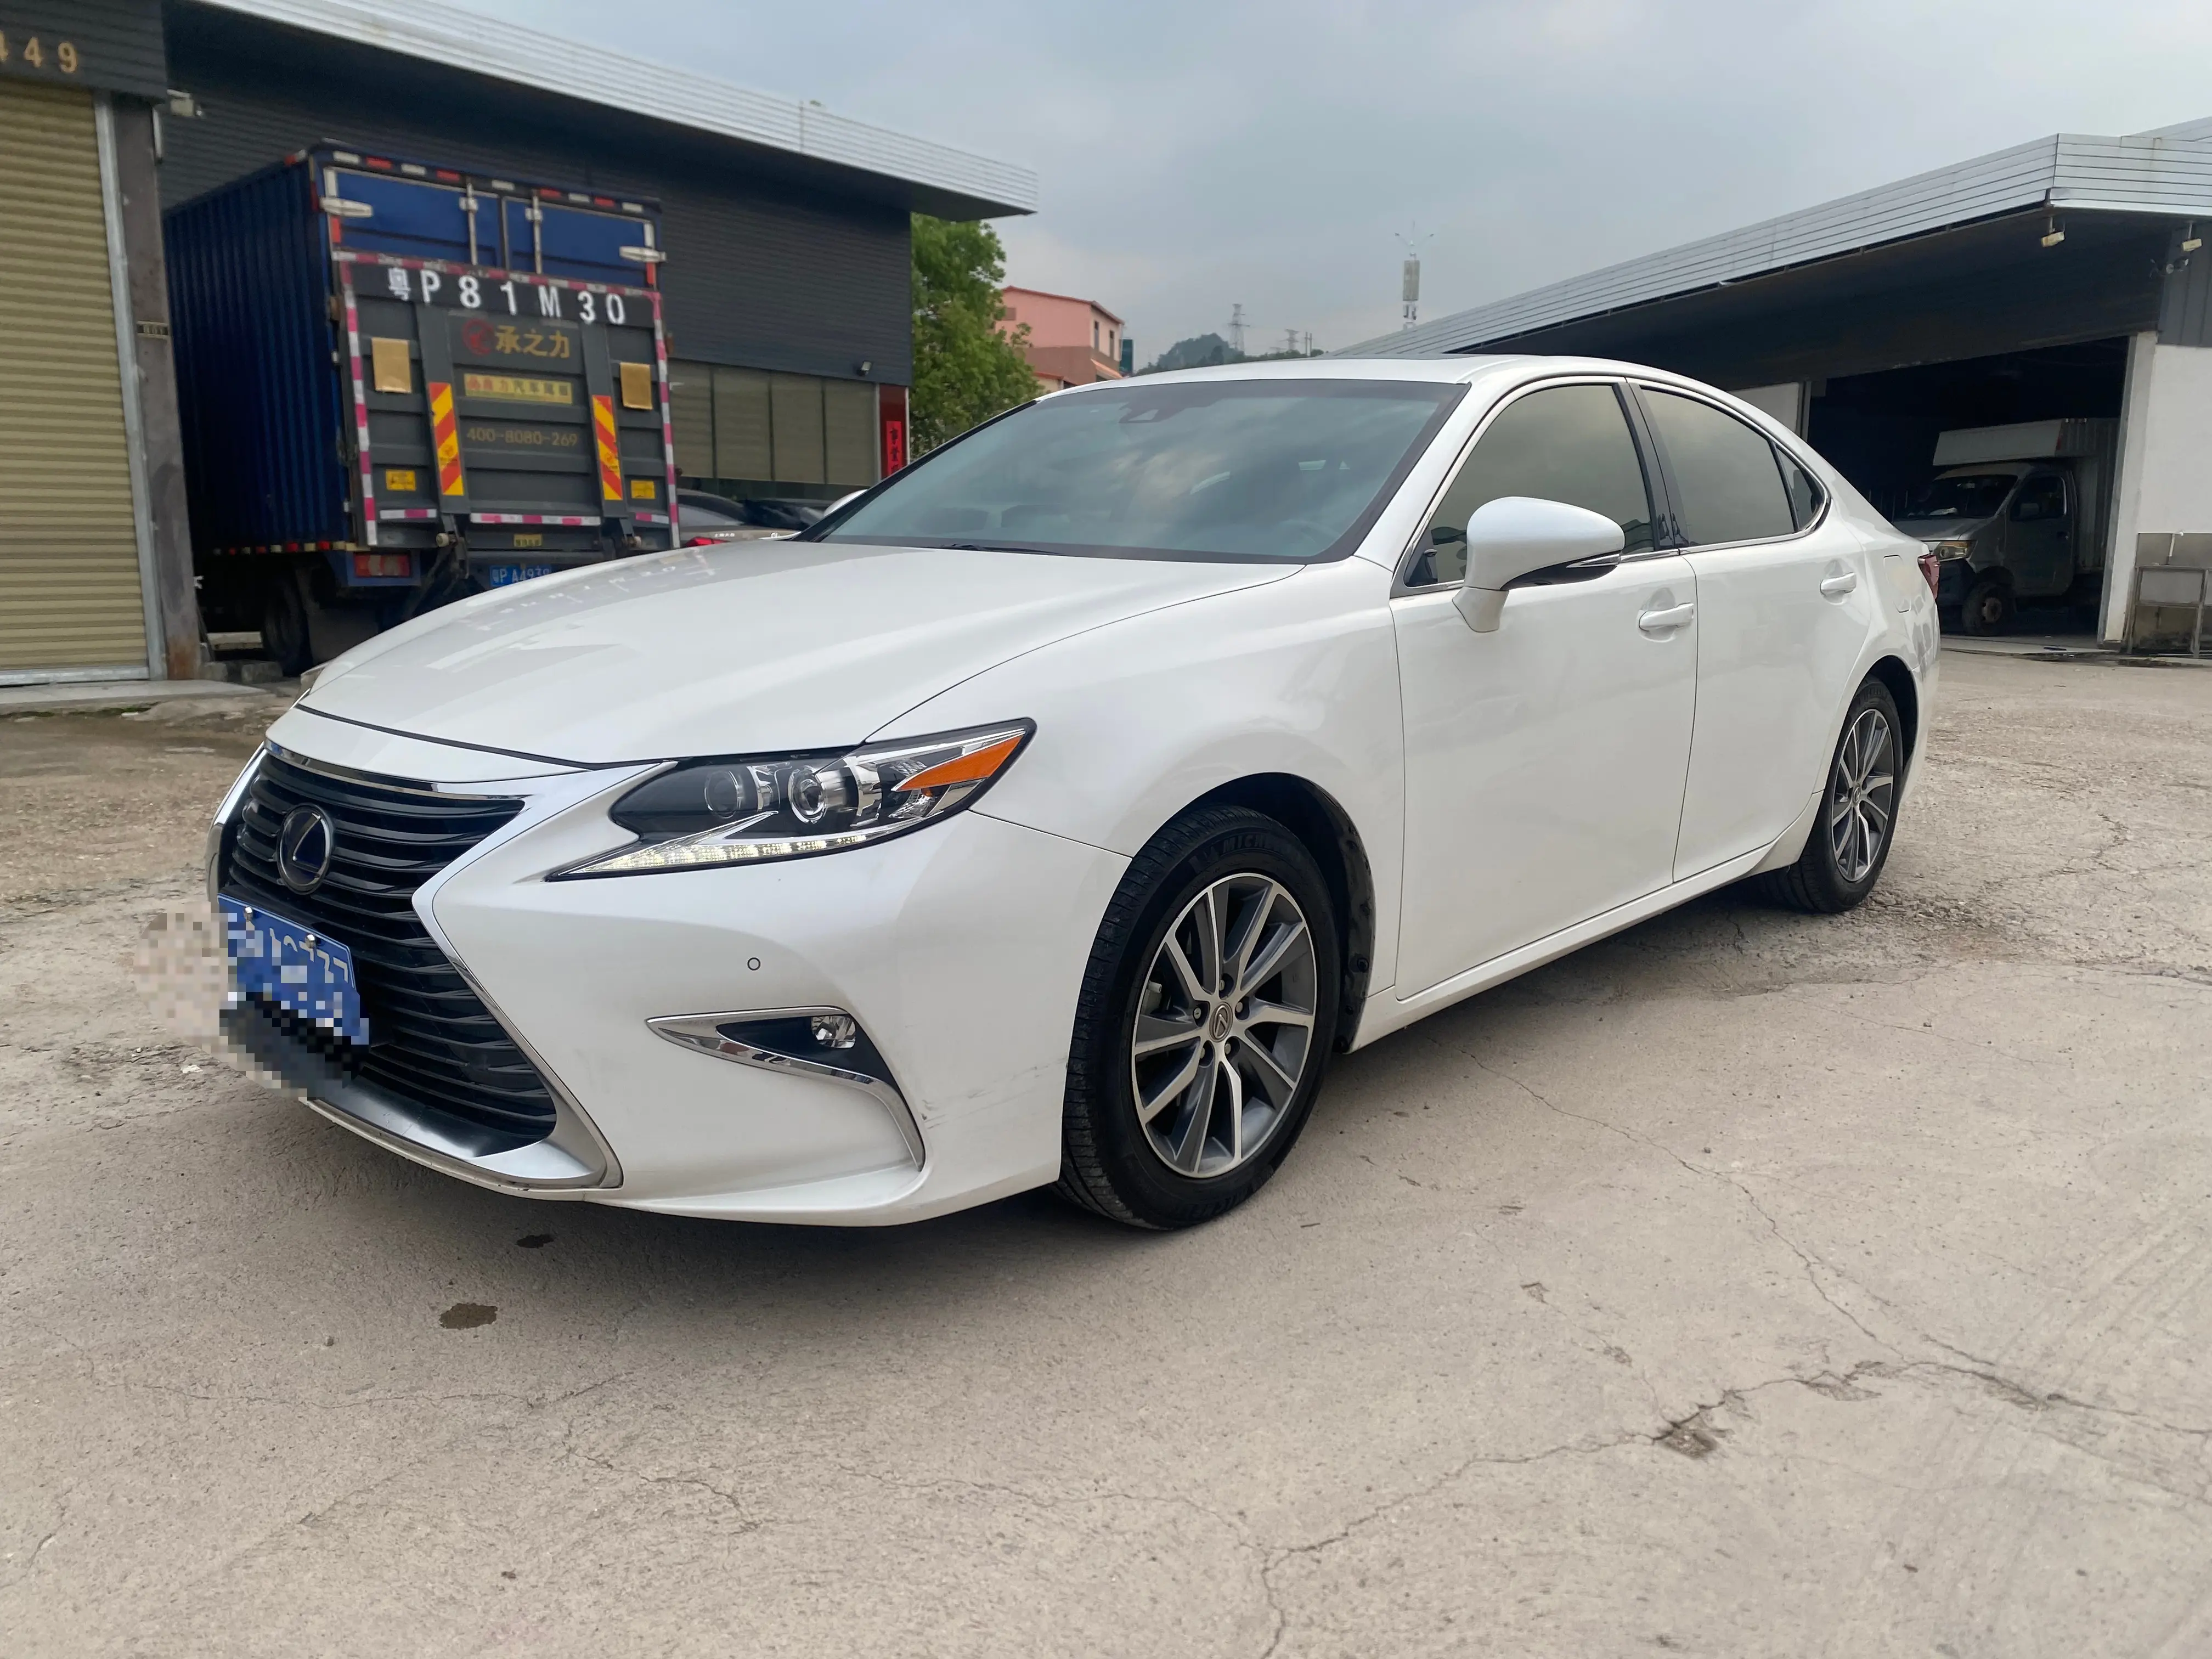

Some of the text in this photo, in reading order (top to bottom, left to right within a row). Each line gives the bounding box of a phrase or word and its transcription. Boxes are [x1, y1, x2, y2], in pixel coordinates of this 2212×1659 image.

[388, 267, 625, 325] 粤P81M30
[494, 325, 570, 359] 承之力
[467, 427, 578, 447] 400-8080-269
